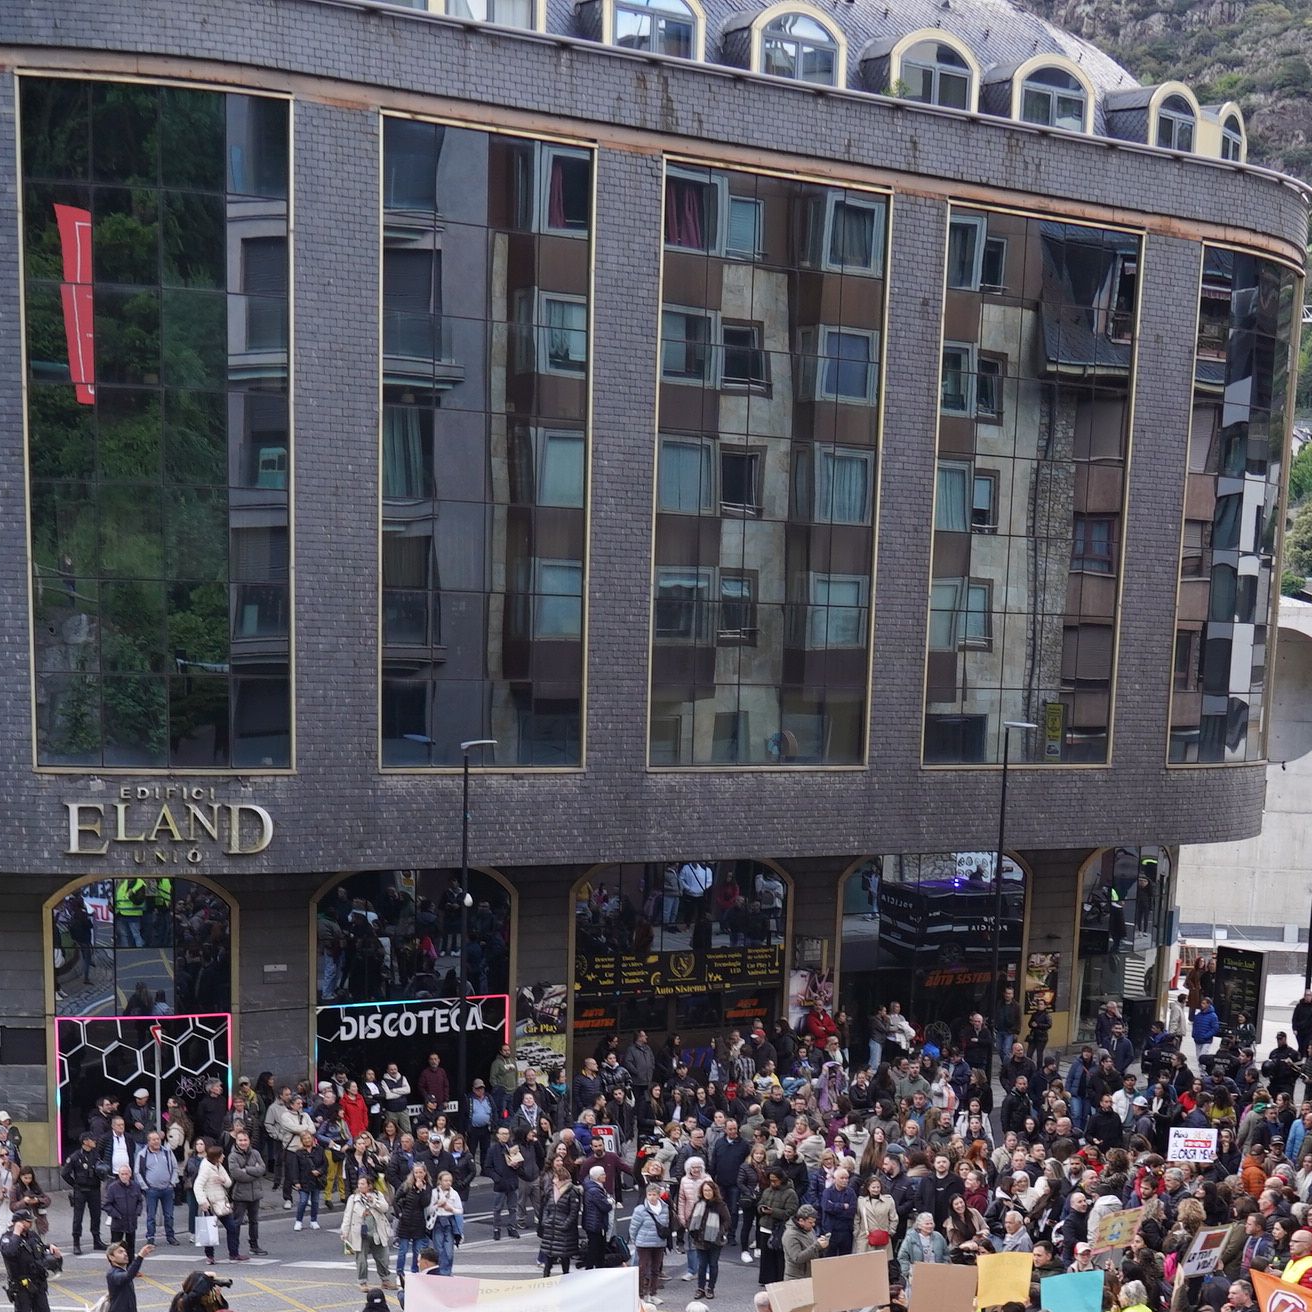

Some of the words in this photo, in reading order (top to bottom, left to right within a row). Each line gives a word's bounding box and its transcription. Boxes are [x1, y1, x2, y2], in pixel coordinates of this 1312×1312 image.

[120, 787, 215, 800] EDIFICI
[63, 802, 274, 855] ELAND
[134, 846, 203, 864] UNIÓ
[955, 971, 993, 985] SISTEM
[654, 985, 674, 996] Auto
[340, 1006, 484, 1041] DISCOTECA
